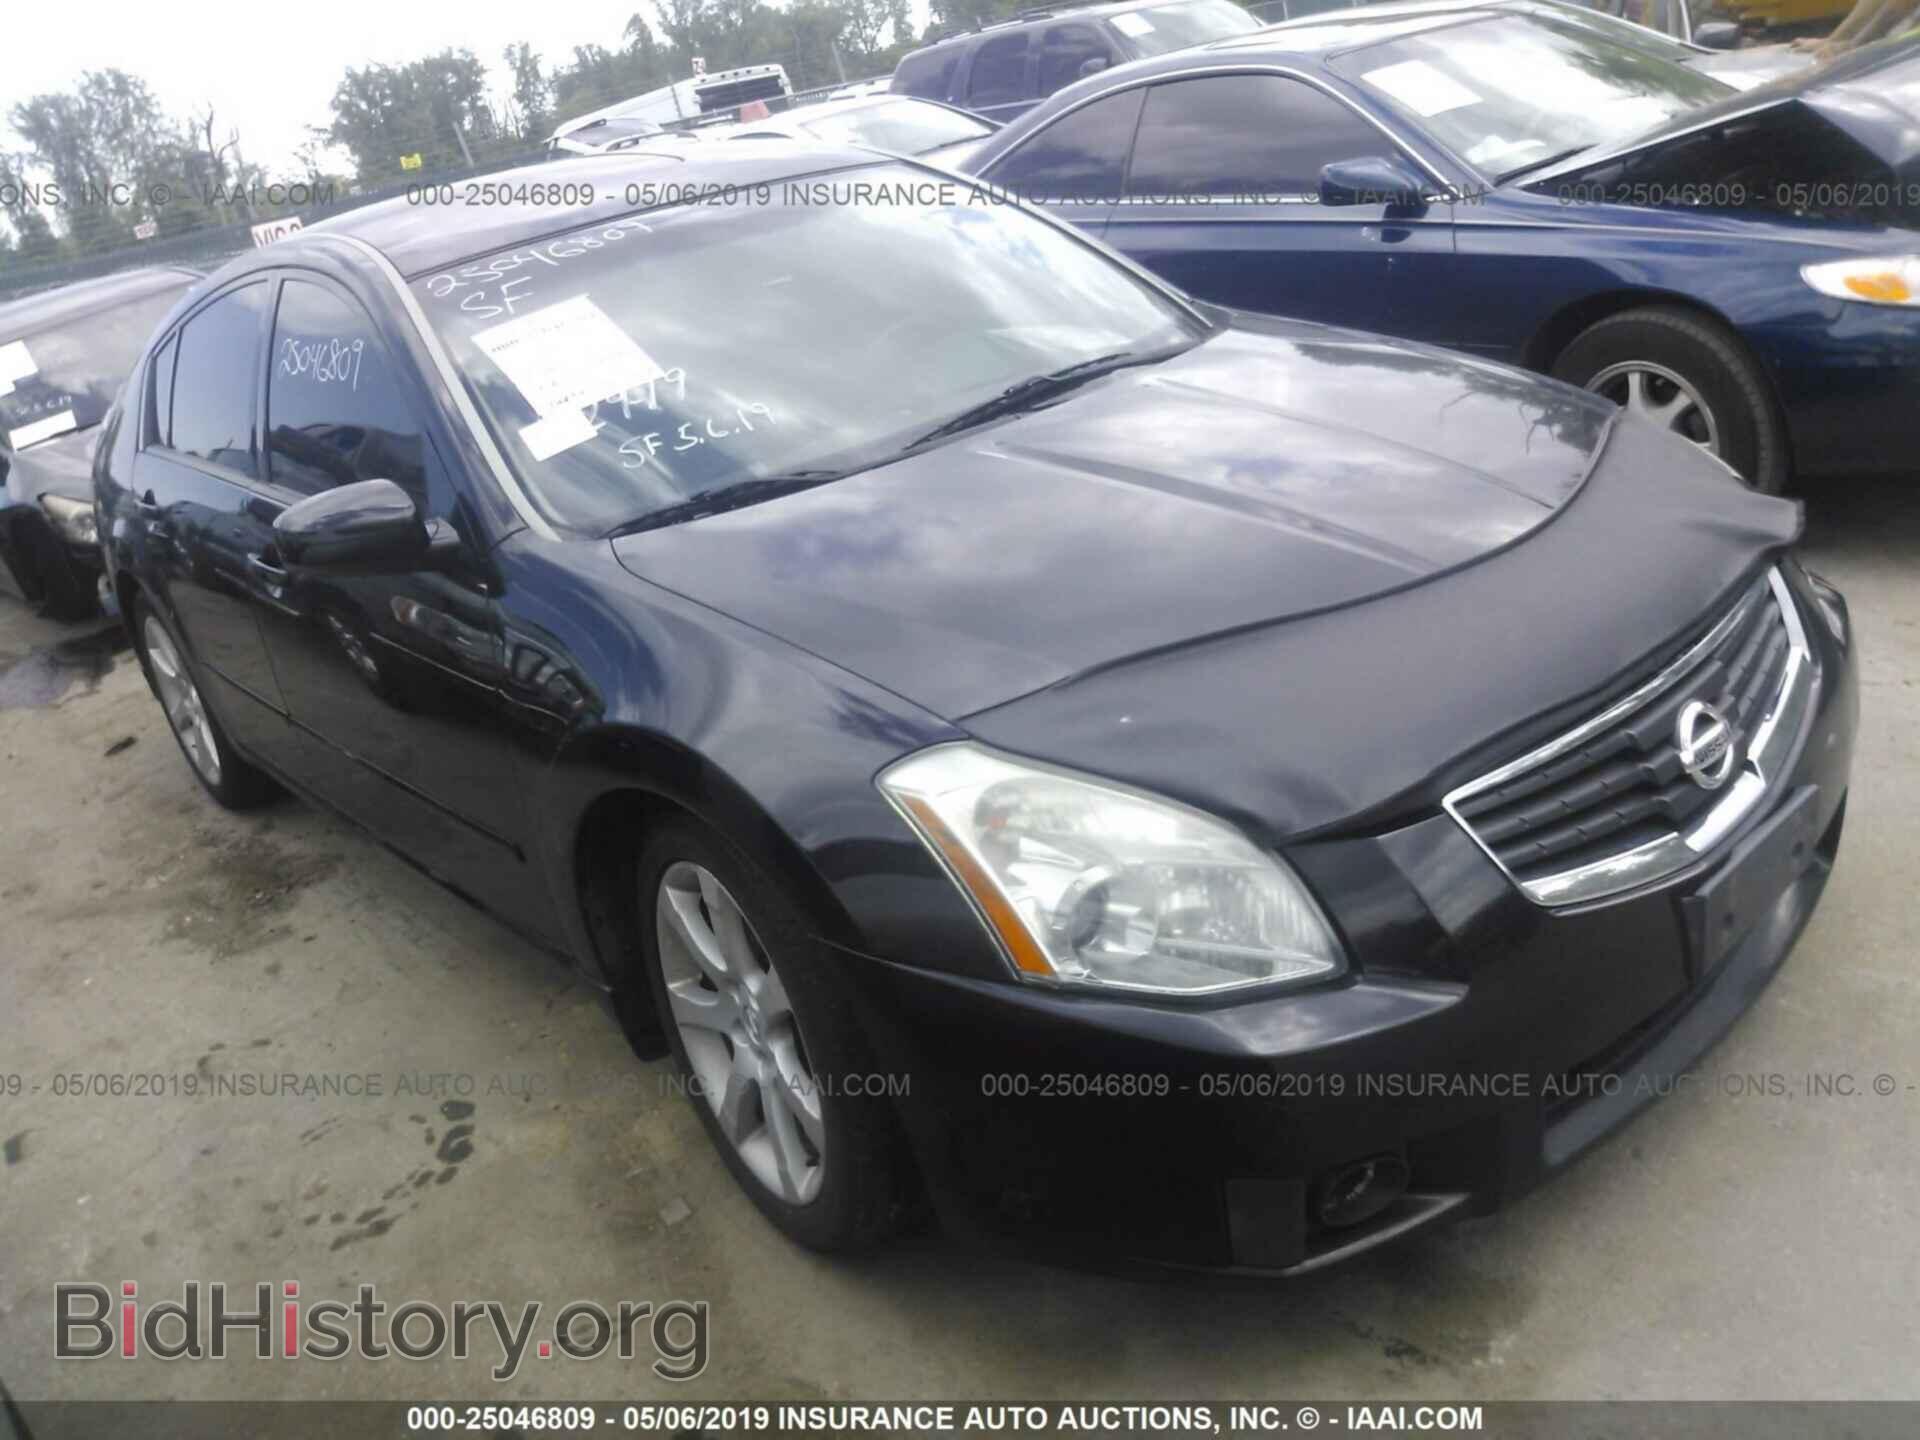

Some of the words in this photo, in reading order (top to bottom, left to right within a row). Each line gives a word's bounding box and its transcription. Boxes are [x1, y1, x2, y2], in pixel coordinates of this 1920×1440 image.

[427, 220, 653, 298] 25046809
[460, 276, 534, 319] SF
[279, 337, 364, 392] 25046809
[618, 432, 663, 468] SF
